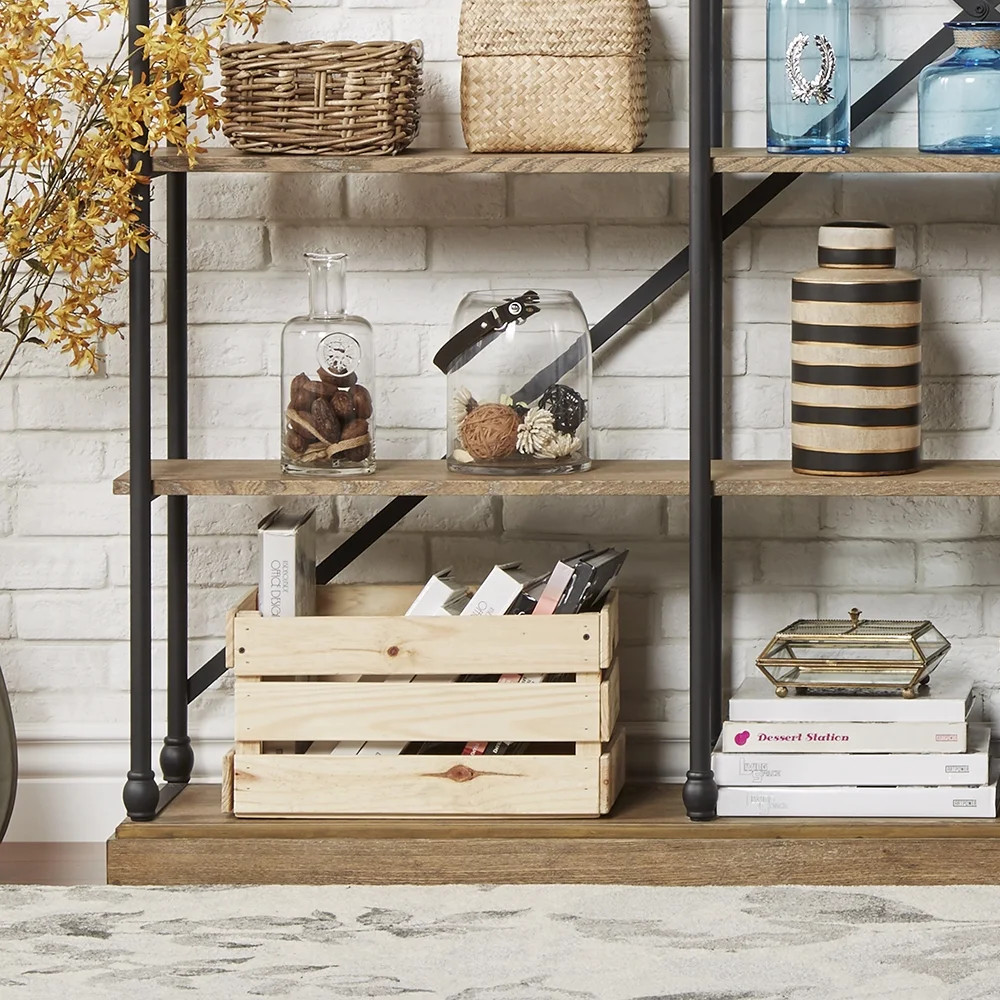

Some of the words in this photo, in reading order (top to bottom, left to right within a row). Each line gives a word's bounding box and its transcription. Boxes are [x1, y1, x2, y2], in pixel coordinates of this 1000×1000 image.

[270, 590, 281, 617] DESIG
[757, 732, 802, 742] Dessert
[806, 732, 850, 742] Station
